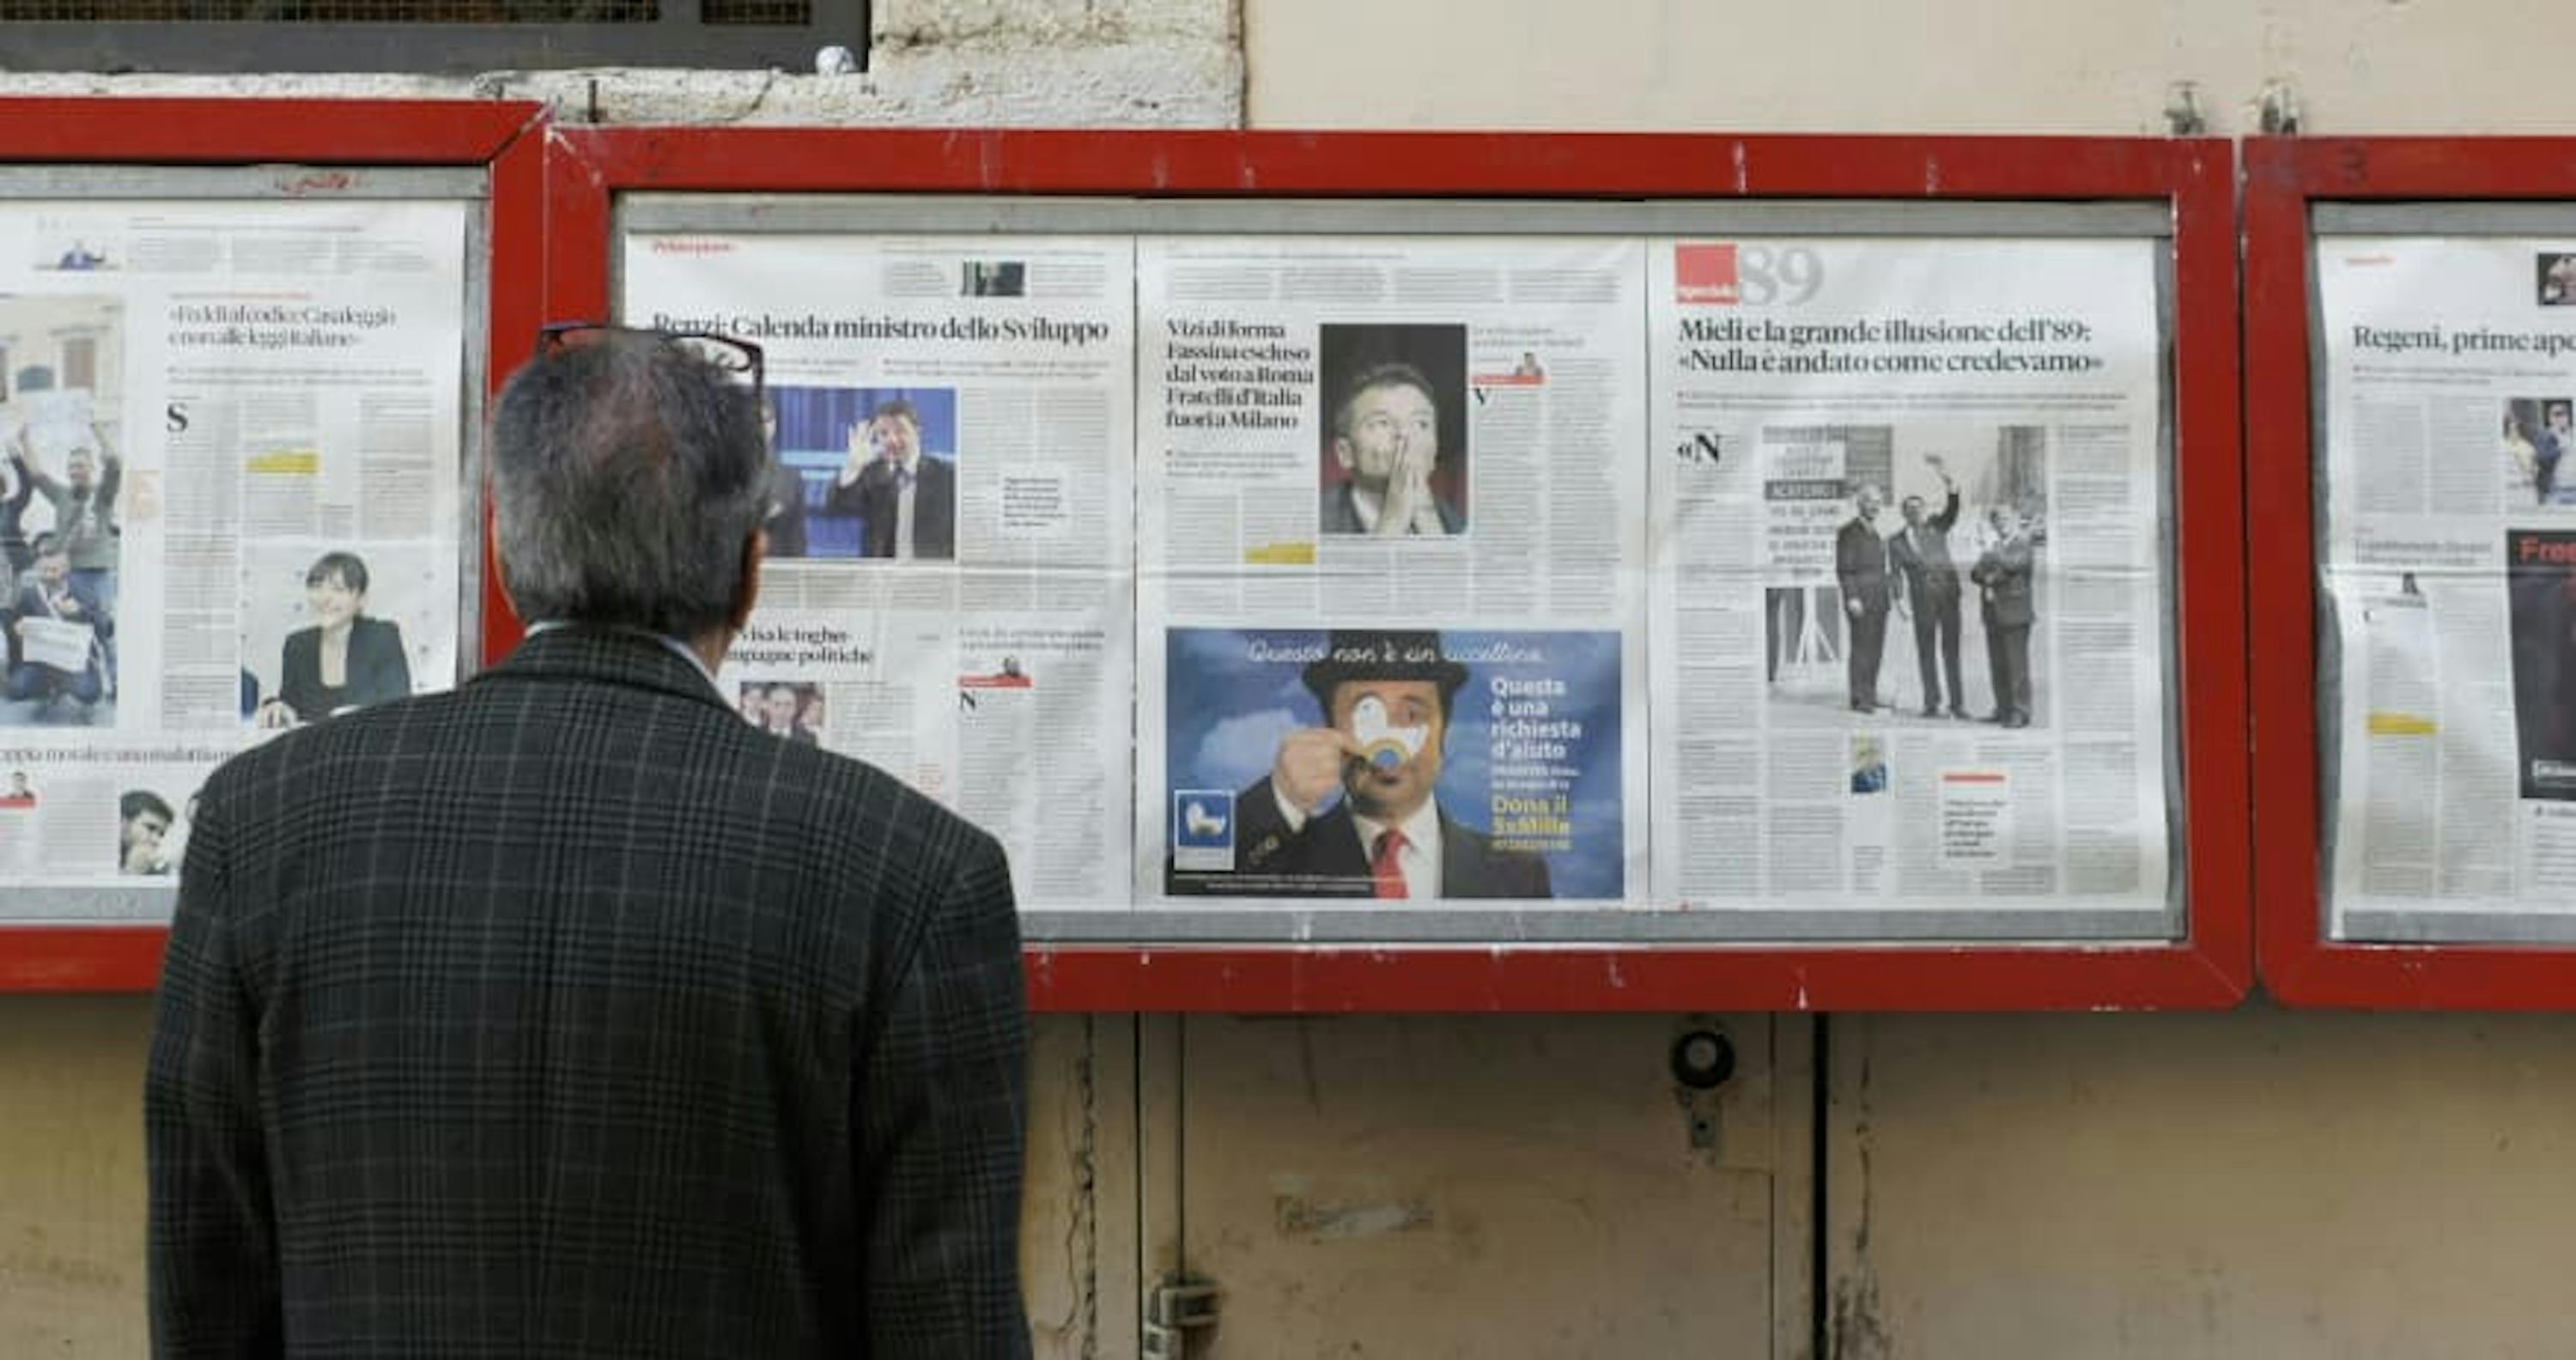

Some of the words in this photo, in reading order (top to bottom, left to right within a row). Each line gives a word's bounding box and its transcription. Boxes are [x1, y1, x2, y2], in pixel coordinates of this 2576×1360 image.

[1740, 246, 1826, 307] 89
[732, 314, 829, 338] Calenda
[834, 315, 938, 338] ministro
[940, 316, 999, 341] dello
[1003, 316, 1109, 346] Sviluppo
[1228, 319, 1285, 337] forma
[1679, 318, 1743, 342] Mieli
[1746, 324, 1760, 342] e
[1764, 318, 1786, 342] la
[1789, 319, 1881, 349] grande
[1885, 319, 1995, 343] illusione
[2353, 325, 2447, 353] Regeni,
[2453, 325, 2530, 355] prime
[1167, 342, 1237, 360] Fassina
[1240, 342, 1311, 361] escluso
[1679, 348, 1757, 371] «Nulla
[1761, 348, 1776, 372] è
[1778, 349, 1869, 373] andato
[1873, 355, 1943, 372] come
[1946, 347, 2104, 372] credevamo»
[1166, 364, 1196, 382] dal
[1199, 366, 1240, 382] voto
[1242, 370, 1255, 382] a
[1257, 367, 1314, 382] Roma
[1167, 387, 1233, 405] Fratelli
[167, 403, 188, 433] S
[1166, 410, 1212, 428] fuori
[1227, 410, 1299, 428] Milano
[1332, 646, 1376, 663] non
[1491, 676, 1568, 700] Questa
[959, 689, 976, 711] N
[1508, 701, 1550, 717] una
[1491, 719, 1582, 740] richiesta
[1491, 740, 1568, 761] d'aiuto
[1491, 794, 1550, 814] Dona
[1555, 793, 1568, 814] il
